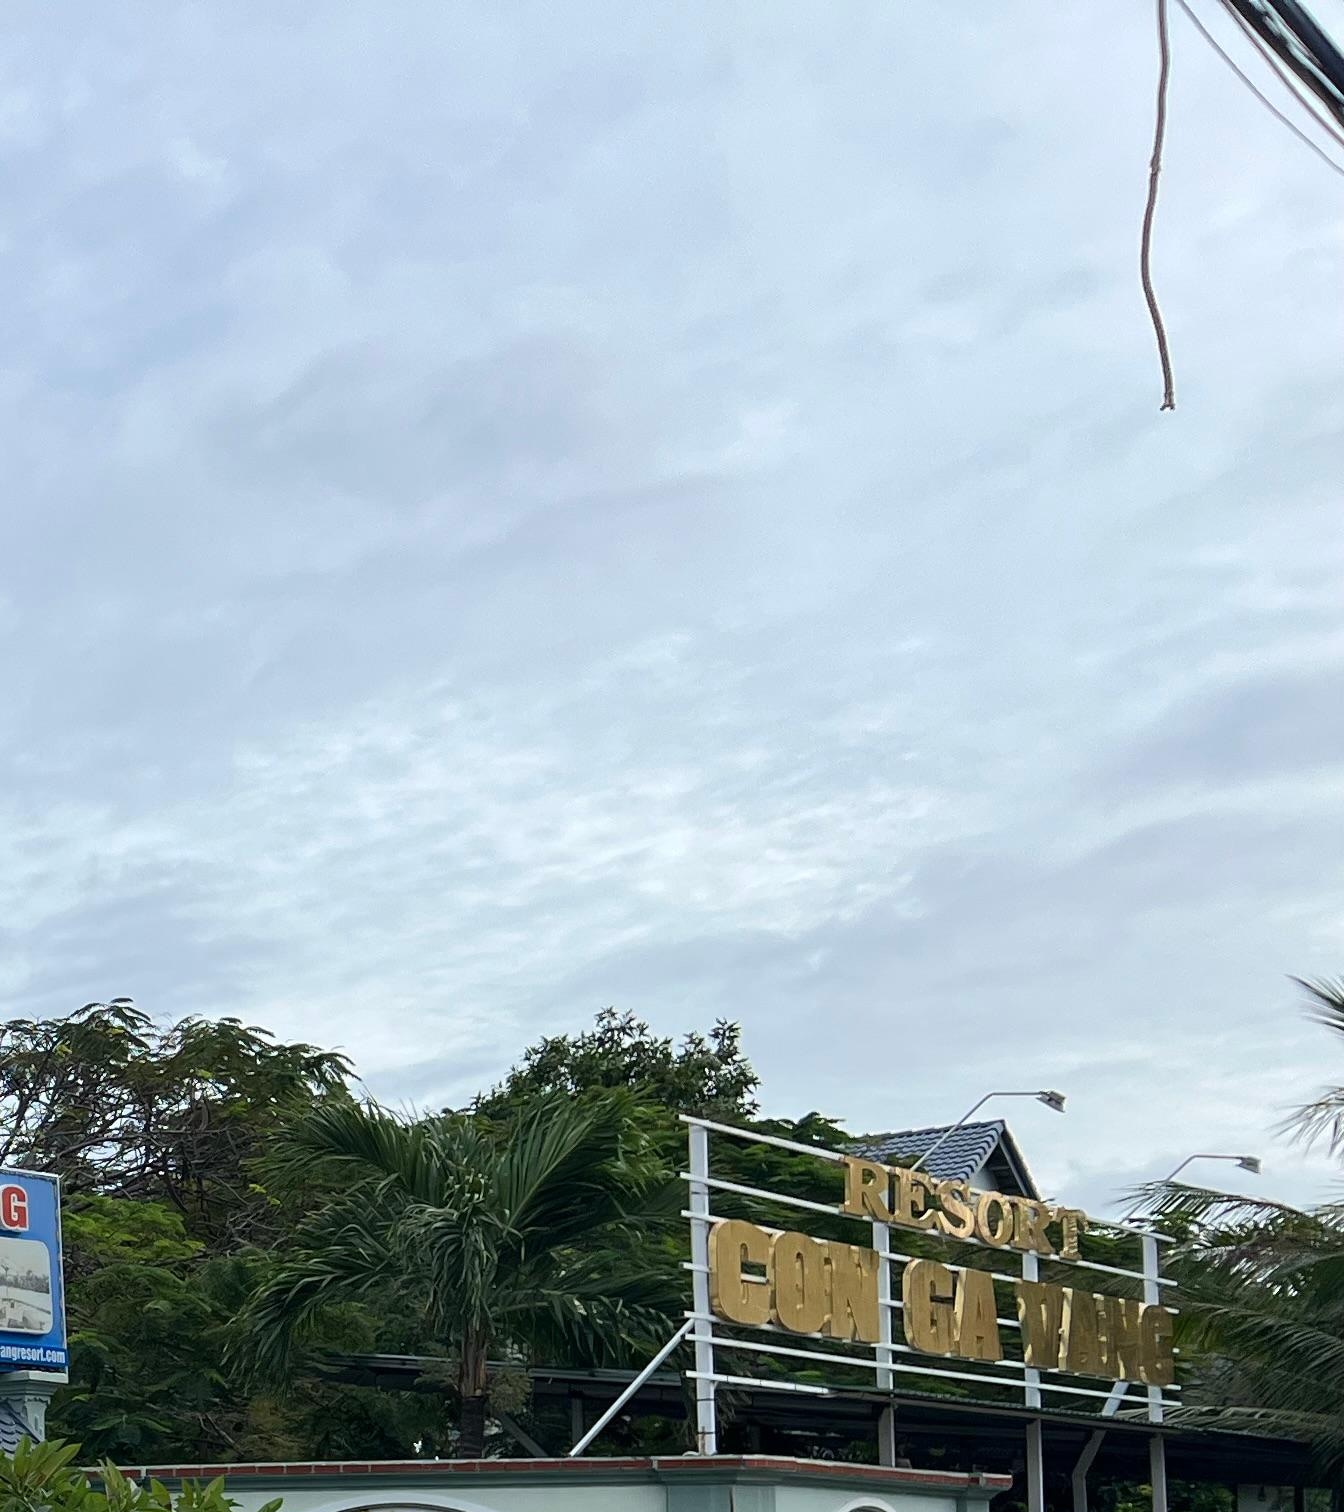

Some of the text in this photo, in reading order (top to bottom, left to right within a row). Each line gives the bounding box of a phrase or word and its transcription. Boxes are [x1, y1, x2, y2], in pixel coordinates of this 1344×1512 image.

[840, 1155, 1087, 1261] RESORT
[709, 1219, 1174, 1386] CON GA VANG
